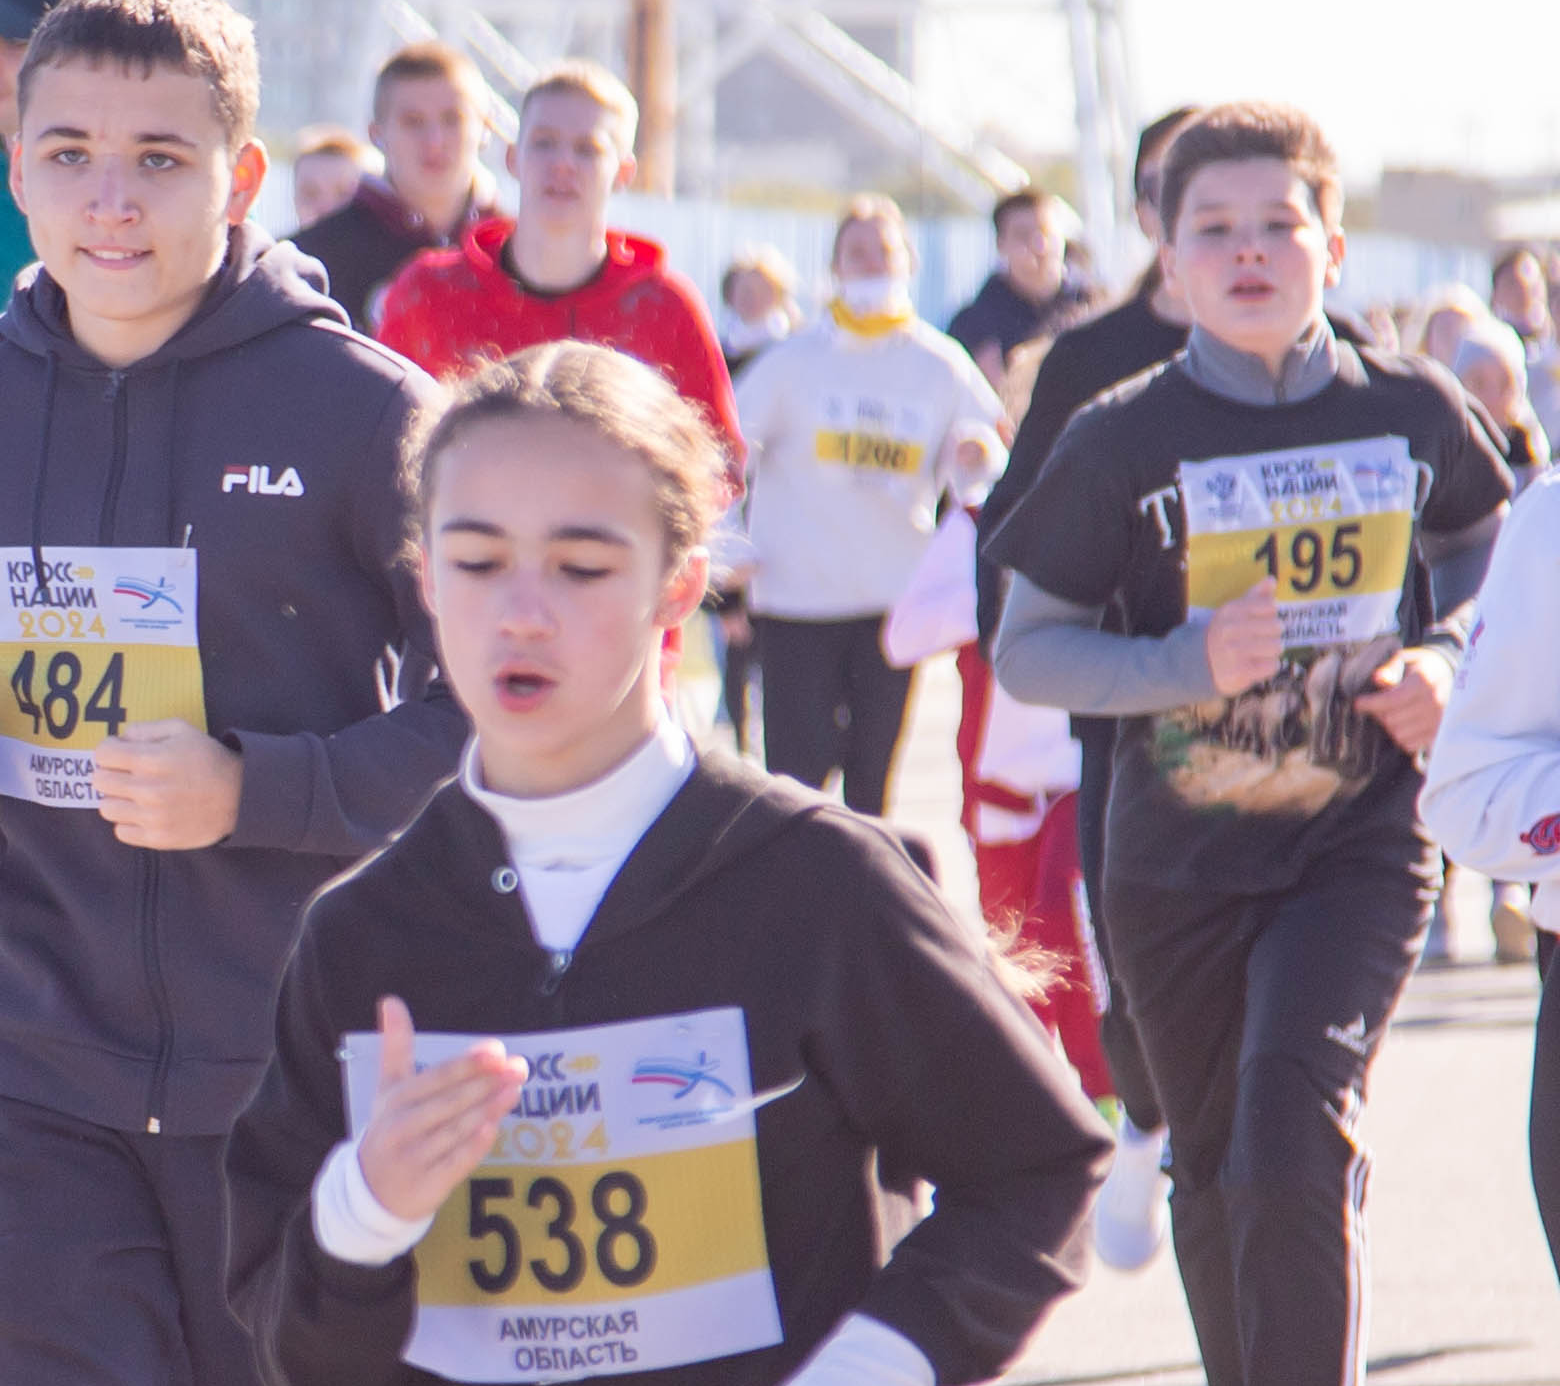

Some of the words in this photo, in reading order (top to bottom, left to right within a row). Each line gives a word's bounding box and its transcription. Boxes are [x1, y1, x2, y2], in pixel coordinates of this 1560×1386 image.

[222, 464, 304, 496] FILA
[1255, 522, 1363, 593] 195
[11, 586, 97, 609] НАЦИИ
[18, 611, 106, 639] 2024
[11, 649, 127, 740] 484
[30, 754, 99, 777] АМУРСКА
[468, 1171, 659, 1295] 538
[499, 1310, 639, 1342] АМУРСКАЯ
[514, 1340, 639, 1372] ОБЛАСТЬ
